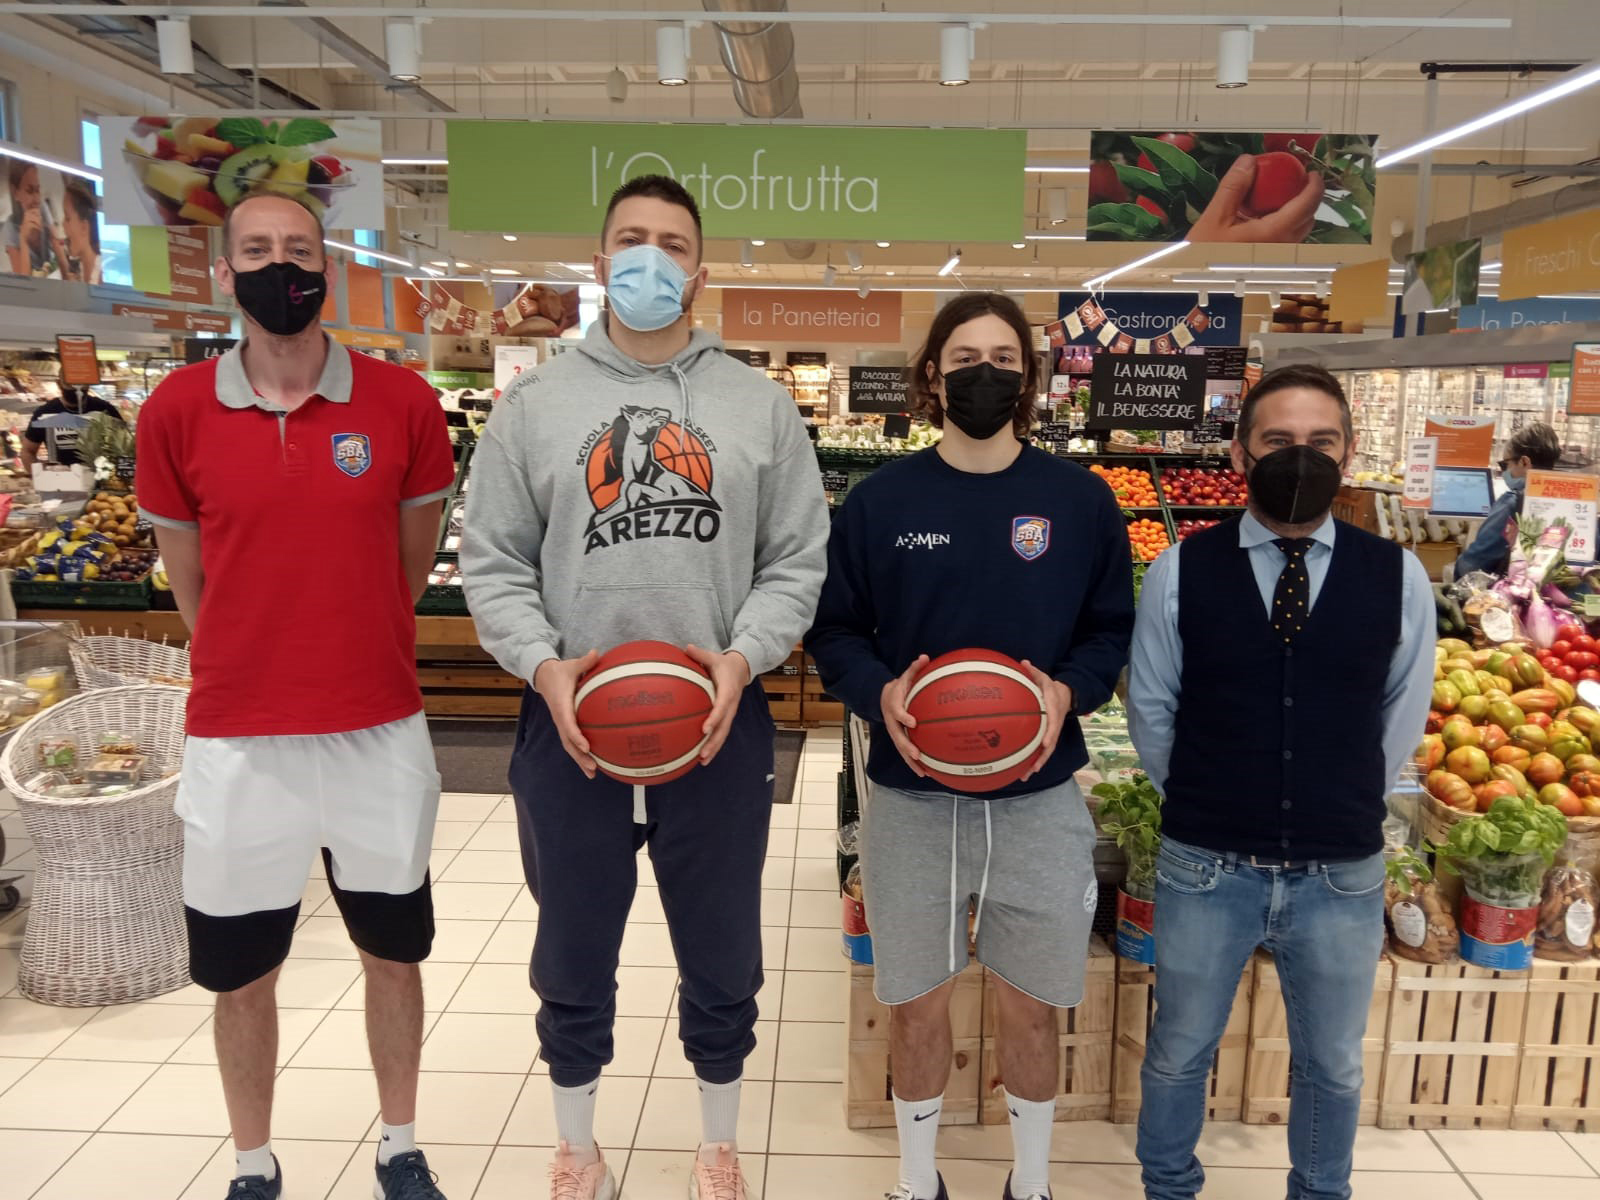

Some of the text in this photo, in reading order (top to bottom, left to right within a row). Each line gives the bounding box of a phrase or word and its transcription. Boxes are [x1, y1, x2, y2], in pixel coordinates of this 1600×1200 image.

[743, 301, 881, 328] la Panetteria
[1113, 361, 1188, 381] LA NATURA
[1113, 382, 1133, 396] LA
[1096, 401, 1198, 420] IL BENESSERE
[576, 421, 611, 467] SCUOLA
[584, 507, 721, 556] AREZZO
[1016, 528, 1044, 543] SBA
